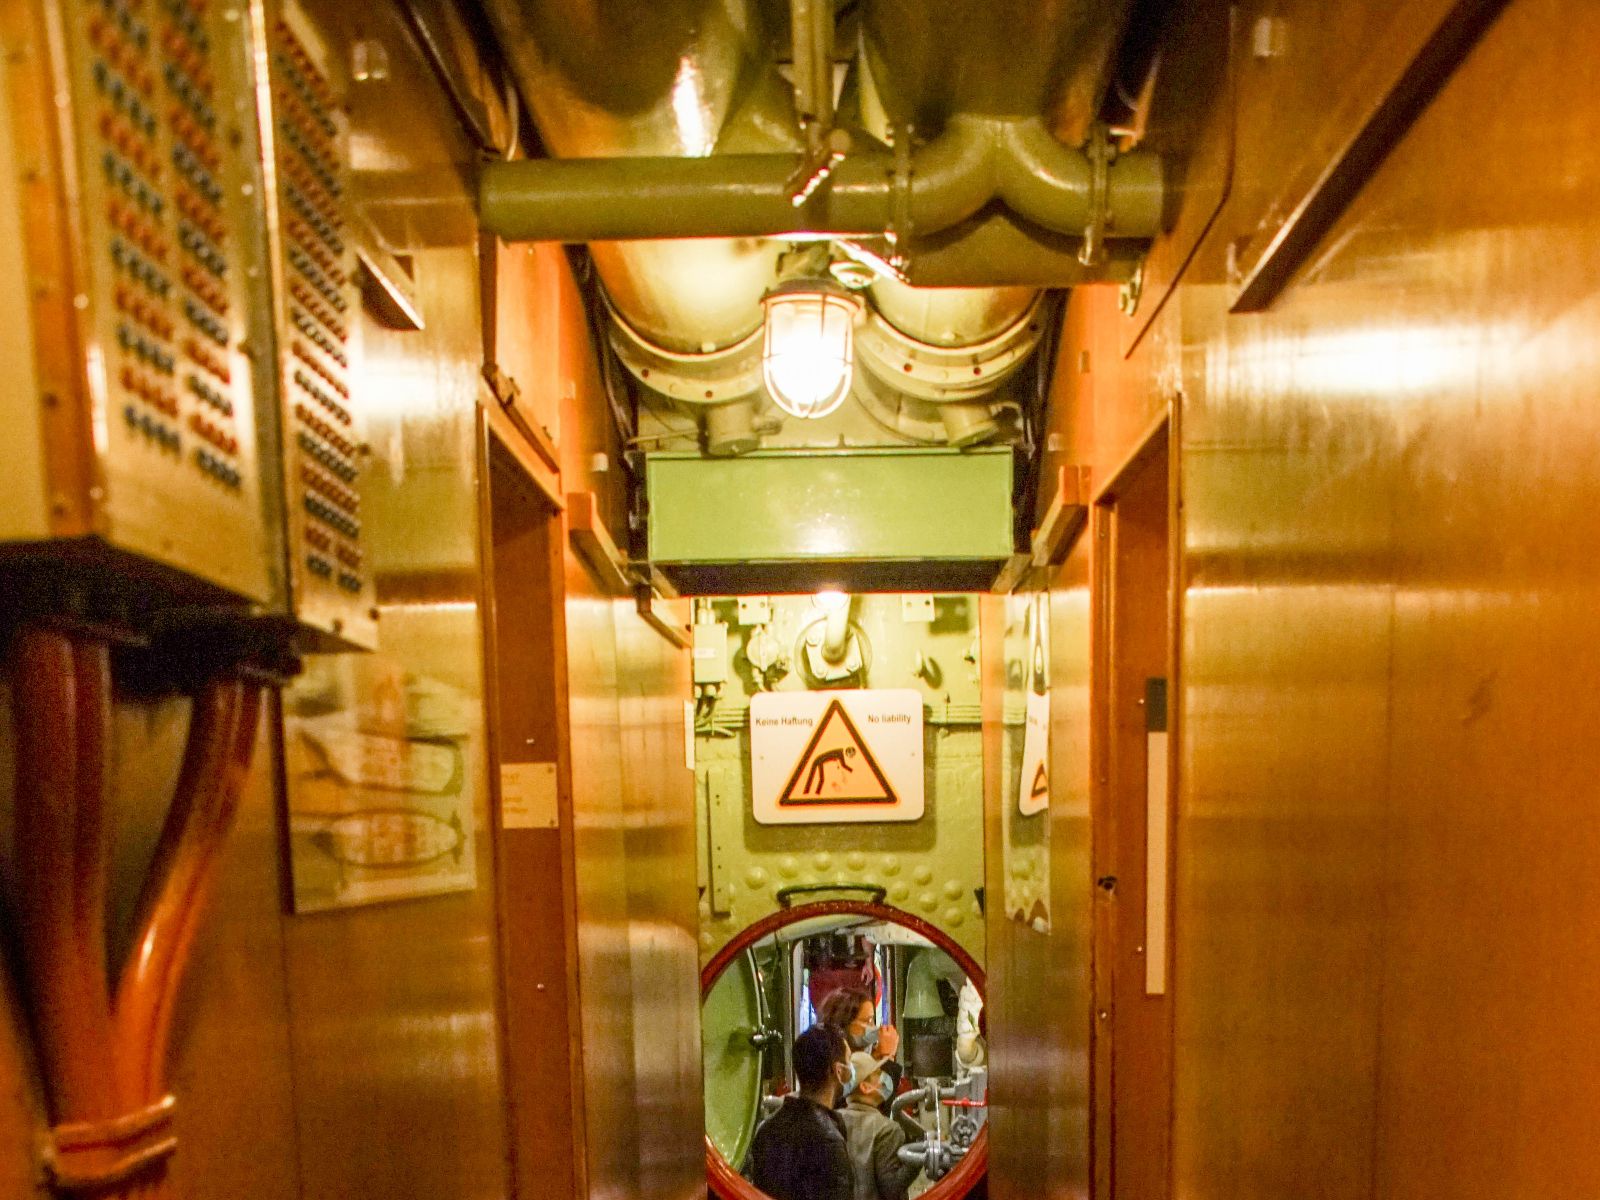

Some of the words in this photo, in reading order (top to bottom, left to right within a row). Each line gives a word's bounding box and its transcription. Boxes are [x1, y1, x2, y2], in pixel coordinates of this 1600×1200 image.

[755, 718, 779, 726] Keine
[781, 717, 813, 727] Haftung
[868, 715, 879, 723] No
[882, 714, 911, 724] liability
